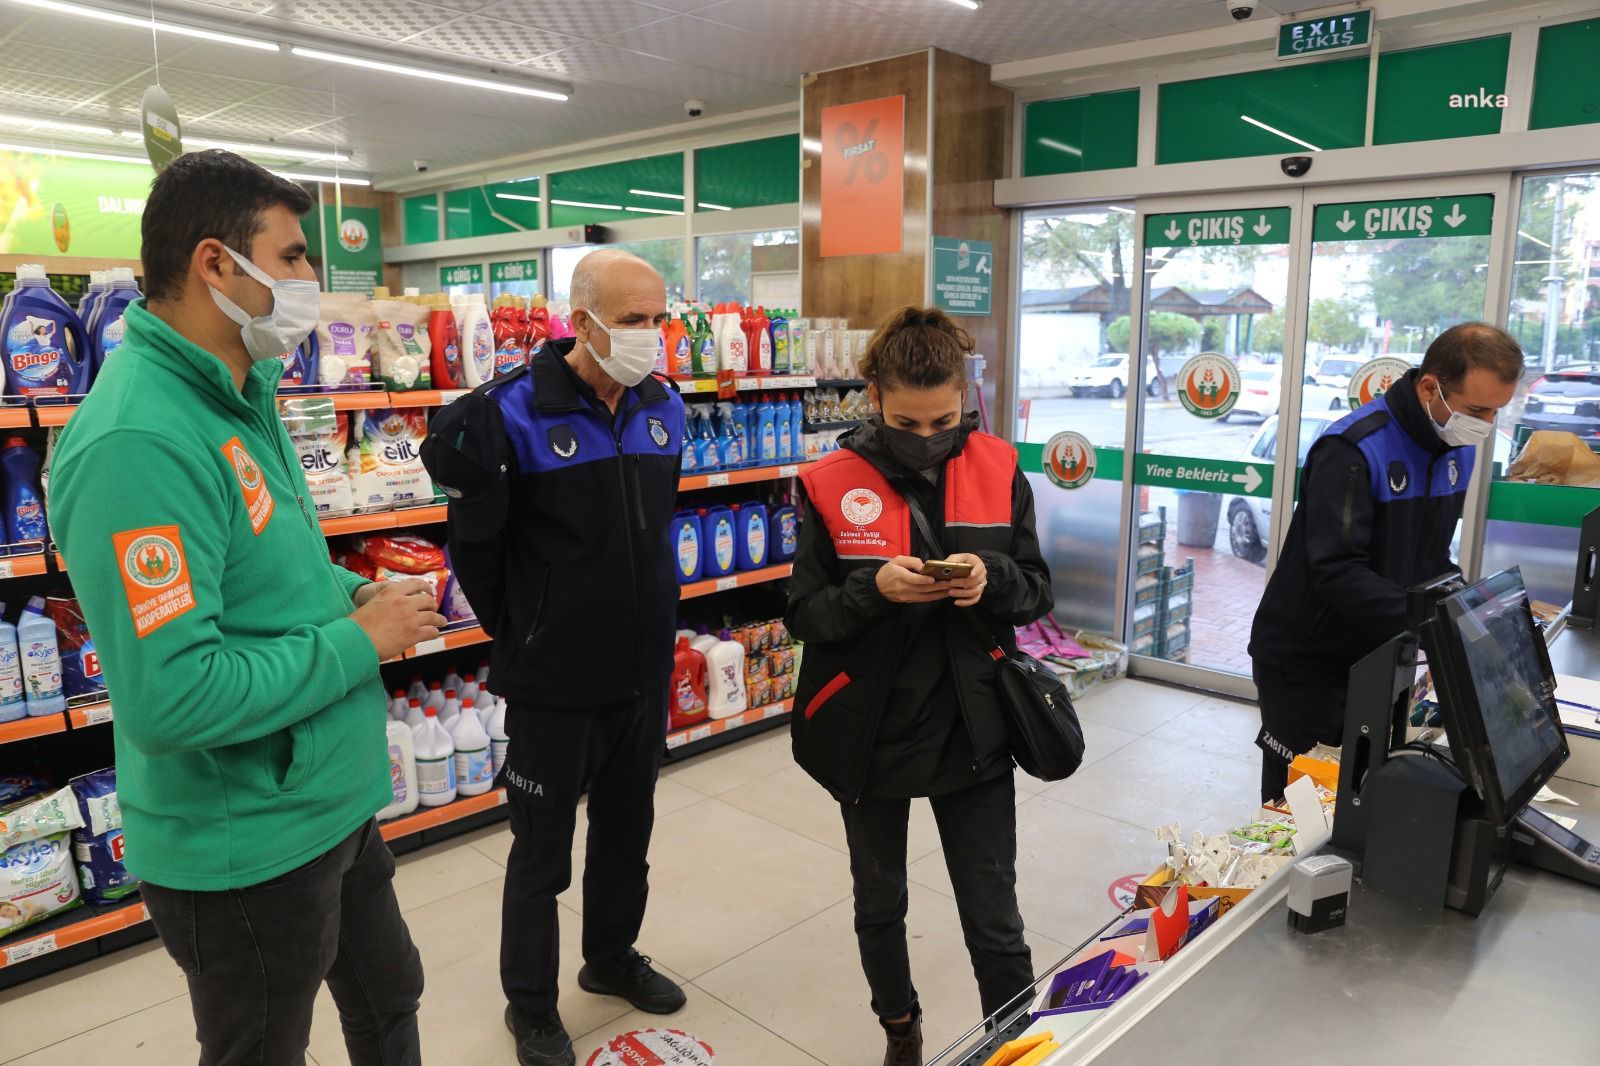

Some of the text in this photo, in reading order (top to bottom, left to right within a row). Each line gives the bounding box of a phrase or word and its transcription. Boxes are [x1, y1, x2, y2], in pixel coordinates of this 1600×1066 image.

[1292, 17, 1355, 39] EXIT
[1292, 31, 1354, 53] ÇIKIŞ
[1188, 216, 1244, 246] ÇIKIŞ
[1364, 205, 1433, 239] ÇIKIŞ
[13, 351, 59, 371] Bingo
[301, 448, 338, 470] elit
[384, 439, 420, 461] elit
[1146, 464, 1230, 483] Yine Bekleriz
[1263, 730, 1294, 762] ZABITA
[505, 764, 544, 797] ZABITA
